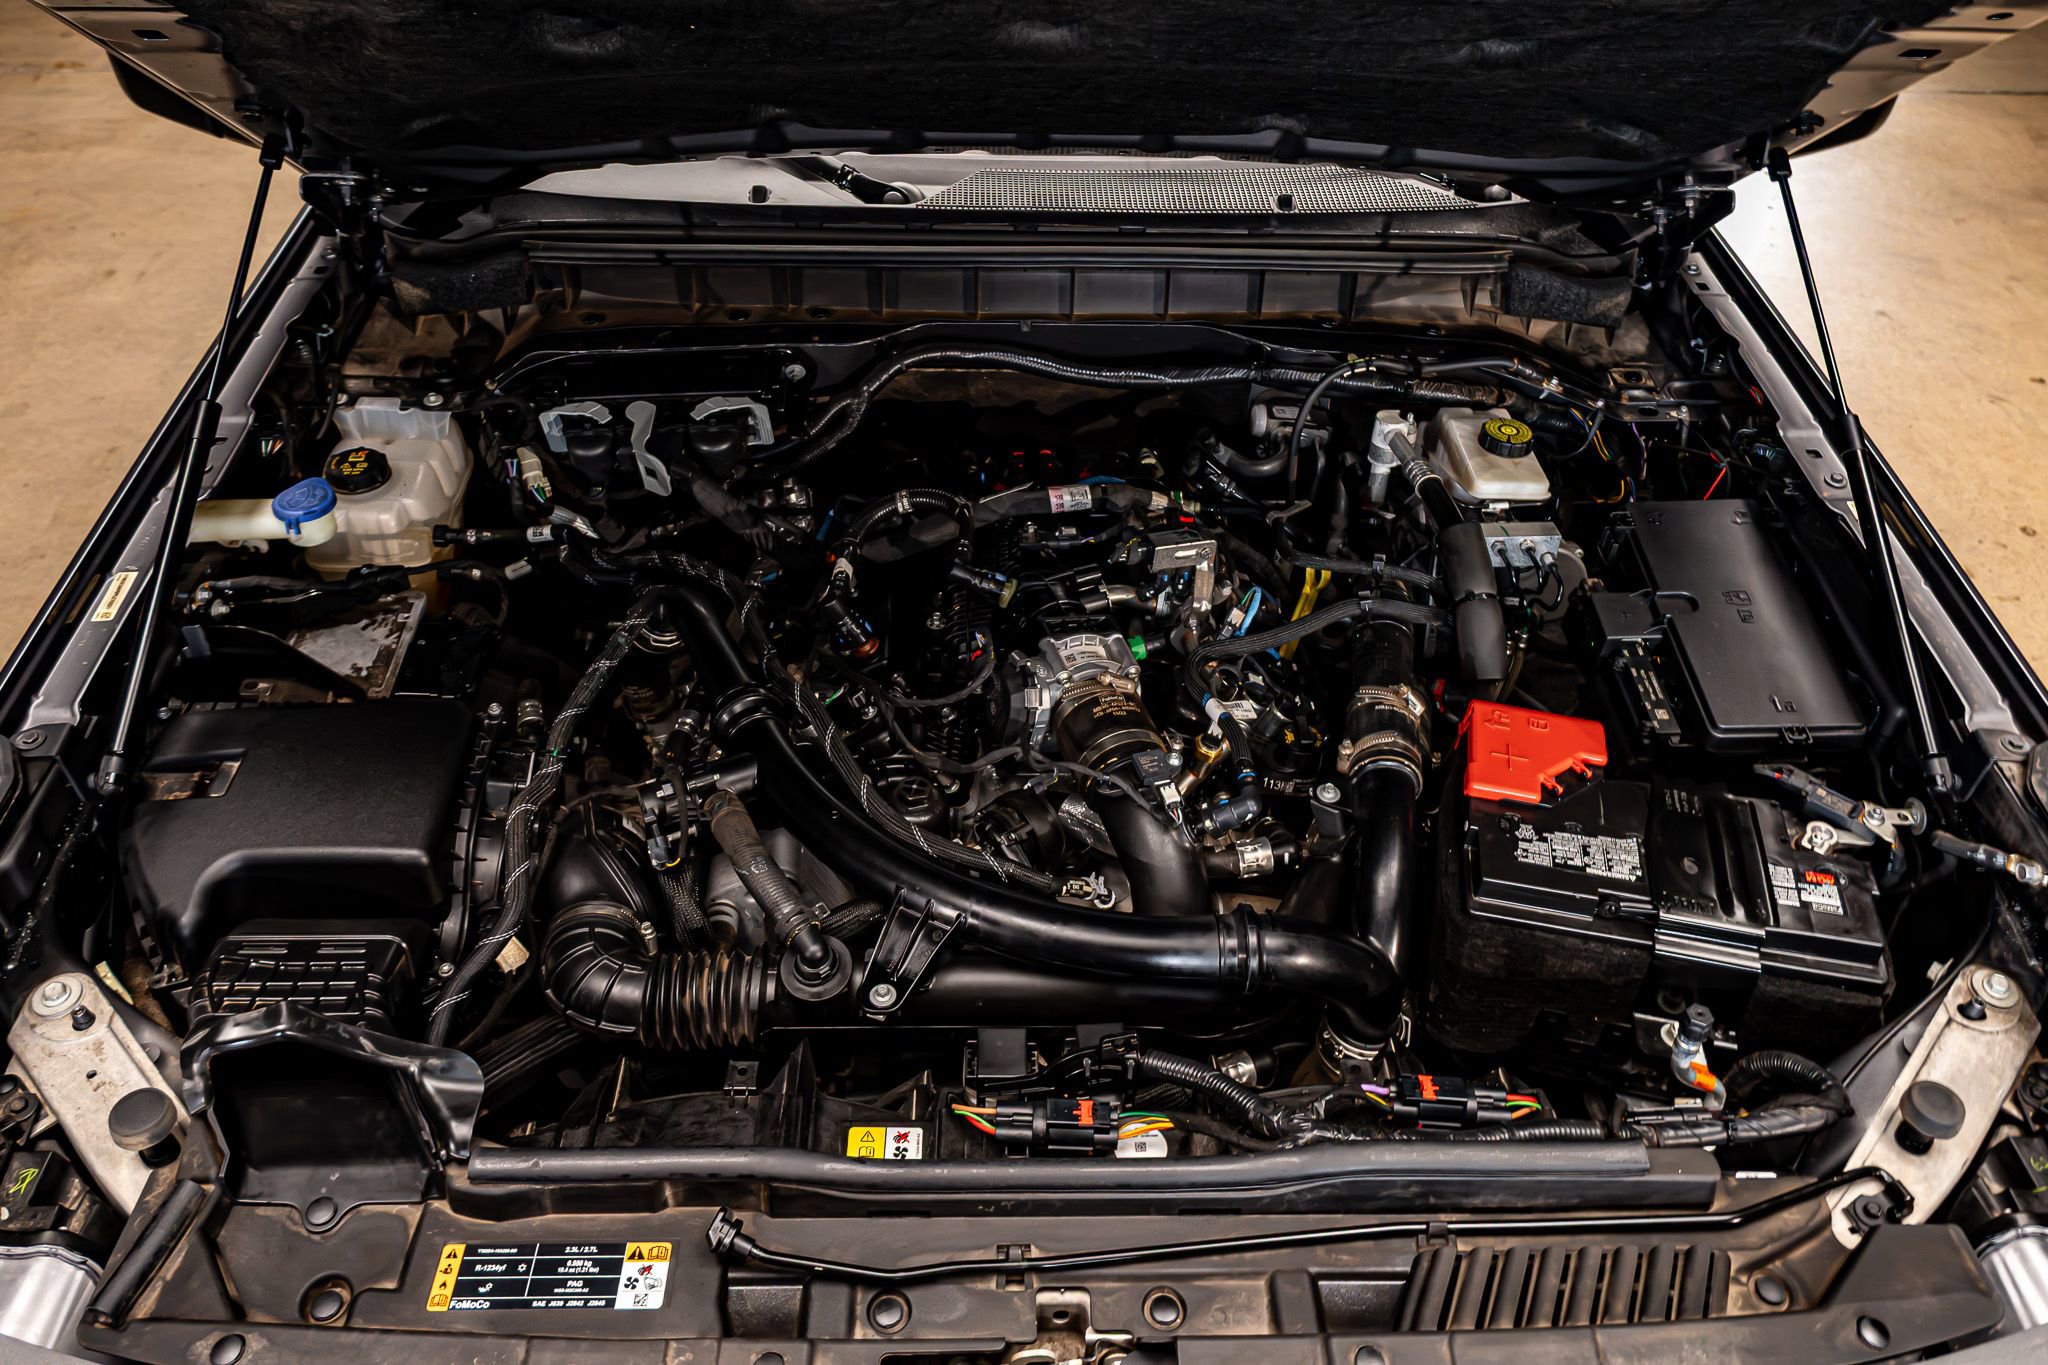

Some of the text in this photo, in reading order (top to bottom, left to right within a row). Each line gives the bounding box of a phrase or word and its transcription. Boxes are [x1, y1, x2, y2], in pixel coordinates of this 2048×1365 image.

[475, 1264, 506, 1273] R-1234yf
[583, 1260, 592, 1268] kg
[449, 1300, 490, 1309] FoMoCo
